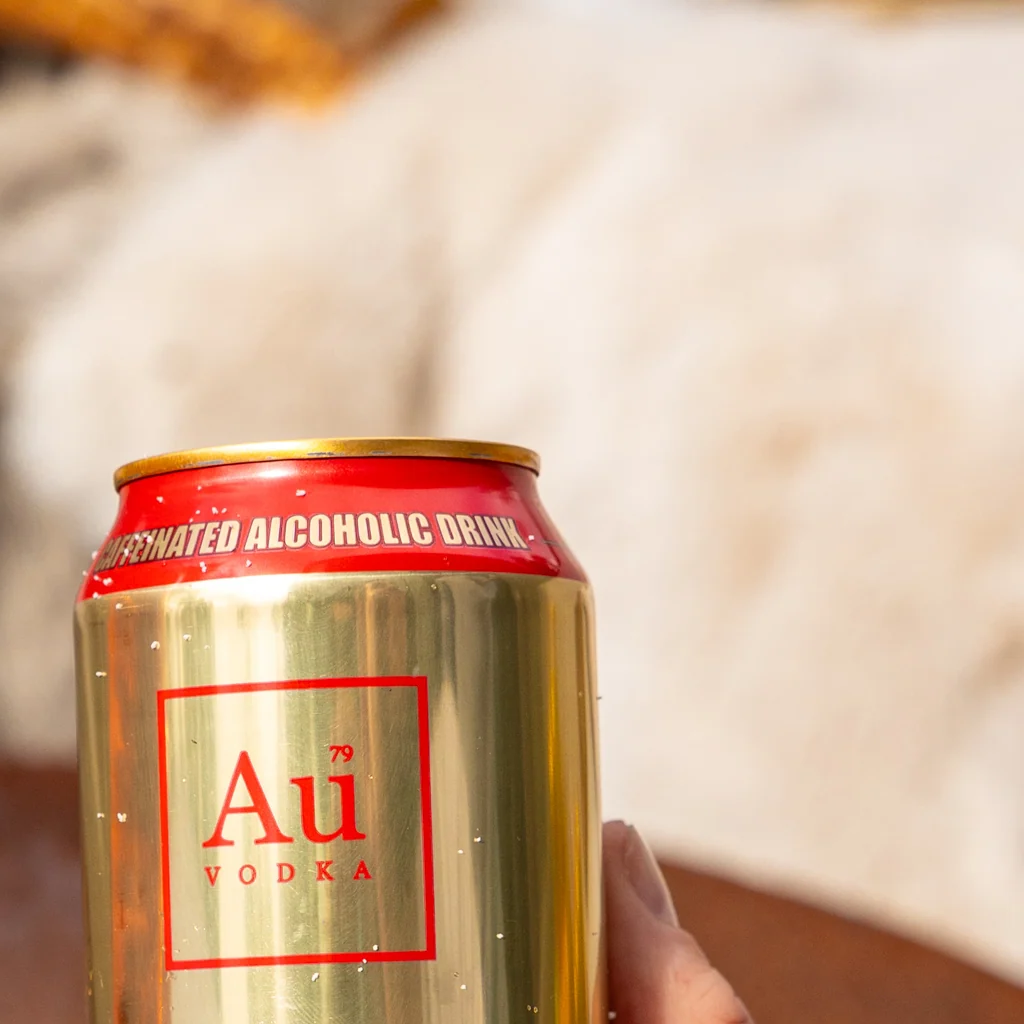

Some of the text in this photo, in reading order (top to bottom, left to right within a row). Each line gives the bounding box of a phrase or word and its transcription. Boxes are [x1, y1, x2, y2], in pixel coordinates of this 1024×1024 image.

[245, 513, 433, 551] ALCOHOLIC
[435, 512, 530, 550] DRINK
[329, 744, 354, 763] 79
[202, 750, 366, 848] Au
[204, 860, 372, 887] VODKA
